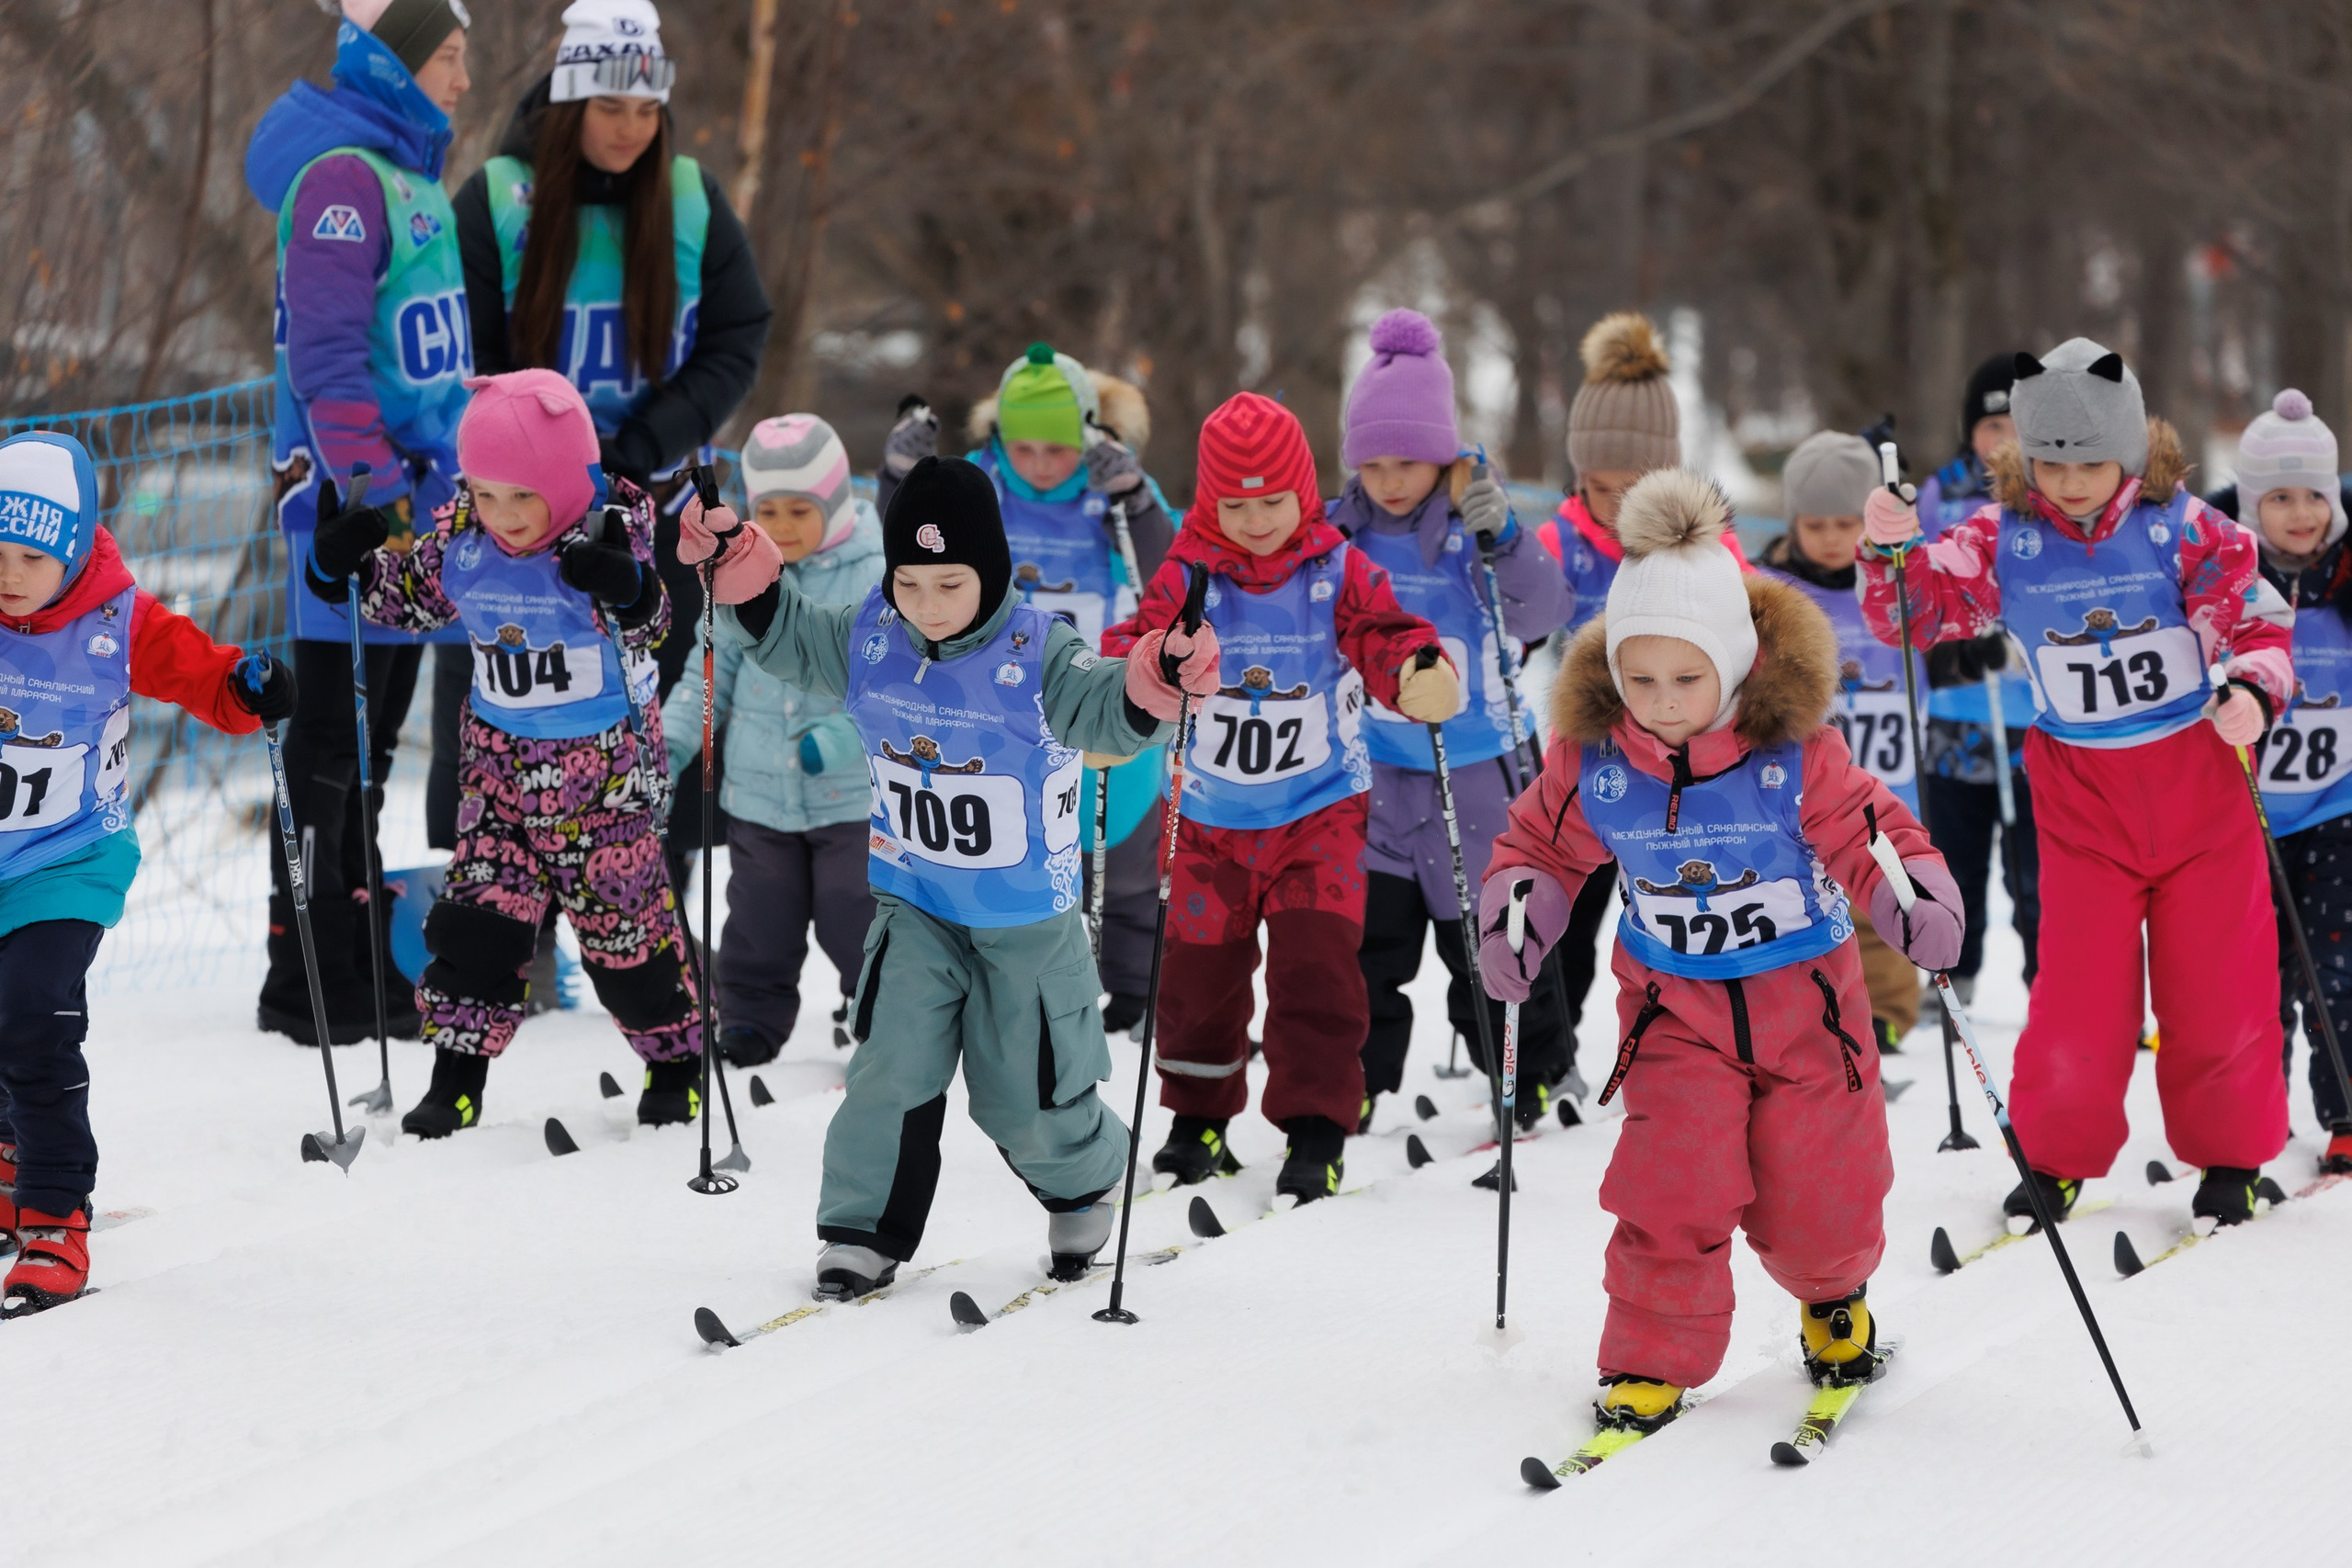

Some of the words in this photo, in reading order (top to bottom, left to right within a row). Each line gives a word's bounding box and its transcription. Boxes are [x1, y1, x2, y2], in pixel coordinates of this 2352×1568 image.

[0, 496, 63, 533] ЖНЯ
[11, 687, 62, 704] МАРАФОН
[28, 677, 96, 696] САХАЛИНСКИЙ
[2066, 650, 2169, 714] 713
[867, 691, 936, 714] МЕЖДУНАРОДНЫЙ
[938, 706, 1005, 724] САХАЛИНСКИЙ
[891, 707, 922, 724] ЛЫЖНЫЙ
[925, 718, 975, 729] МАРАФОН
[271, 746, 282, 770] TOP
[1213, 712, 1305, 775] 702
[275, 770, 288, 808] SPEED
[888, 779, 992, 857] 709
[1611, 823, 1704, 840] МЕЖДУНАРДНЫЙ
[1707, 821, 1779, 834] САХАЛИНСКИЙ
[1668, 794, 1679, 831] RELMO
[1645, 838, 1690, 852] ЛЫЖНЫЙ
[1693, 836, 1747, 848] МАРАФОН
[288, 854, 304, 887] TREK
[1655, 902, 1778, 955] 725
[1503, 1022, 1517, 1076] sable
[1601, 1037, 1636, 1105] RELMO
